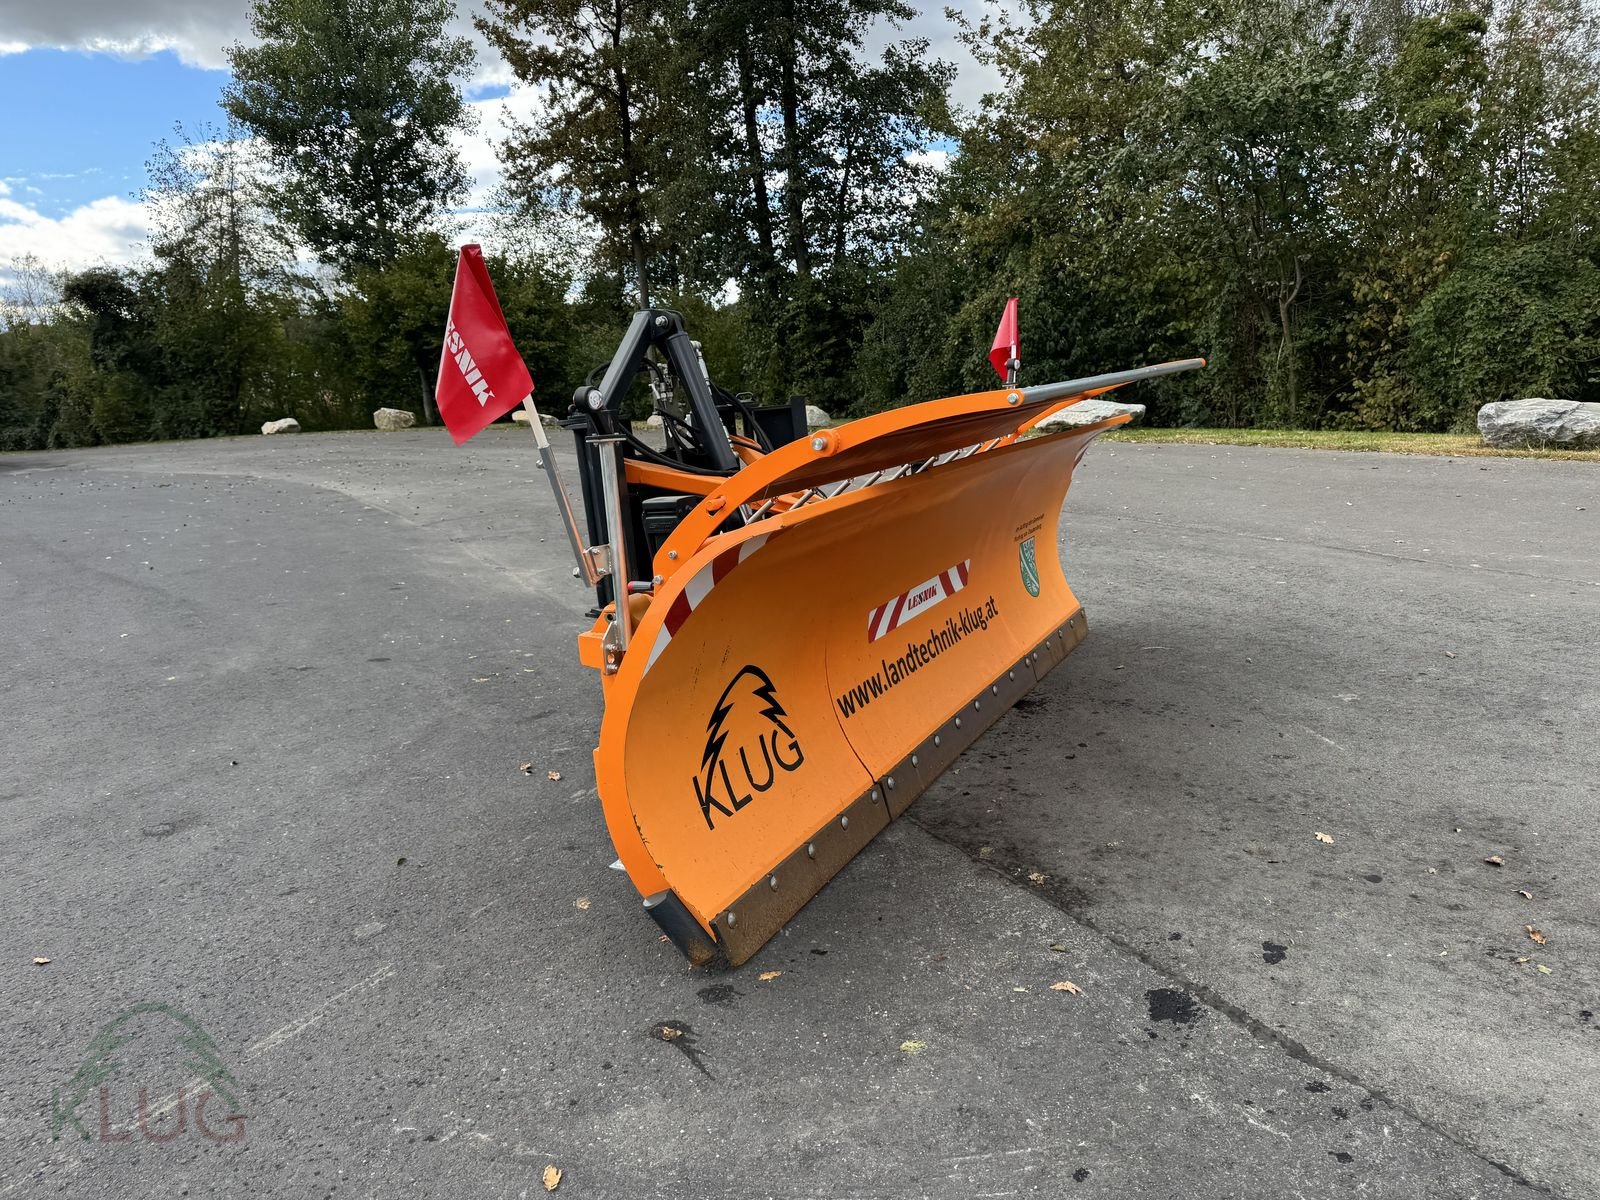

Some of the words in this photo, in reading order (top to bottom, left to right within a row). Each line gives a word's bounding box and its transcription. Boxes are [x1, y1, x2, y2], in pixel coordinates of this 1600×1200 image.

[907, 584, 938, 611] LESNIK
[836, 595, 999, 719] www.landtechnik-klug.at
[692, 729, 805, 831] KLUG
